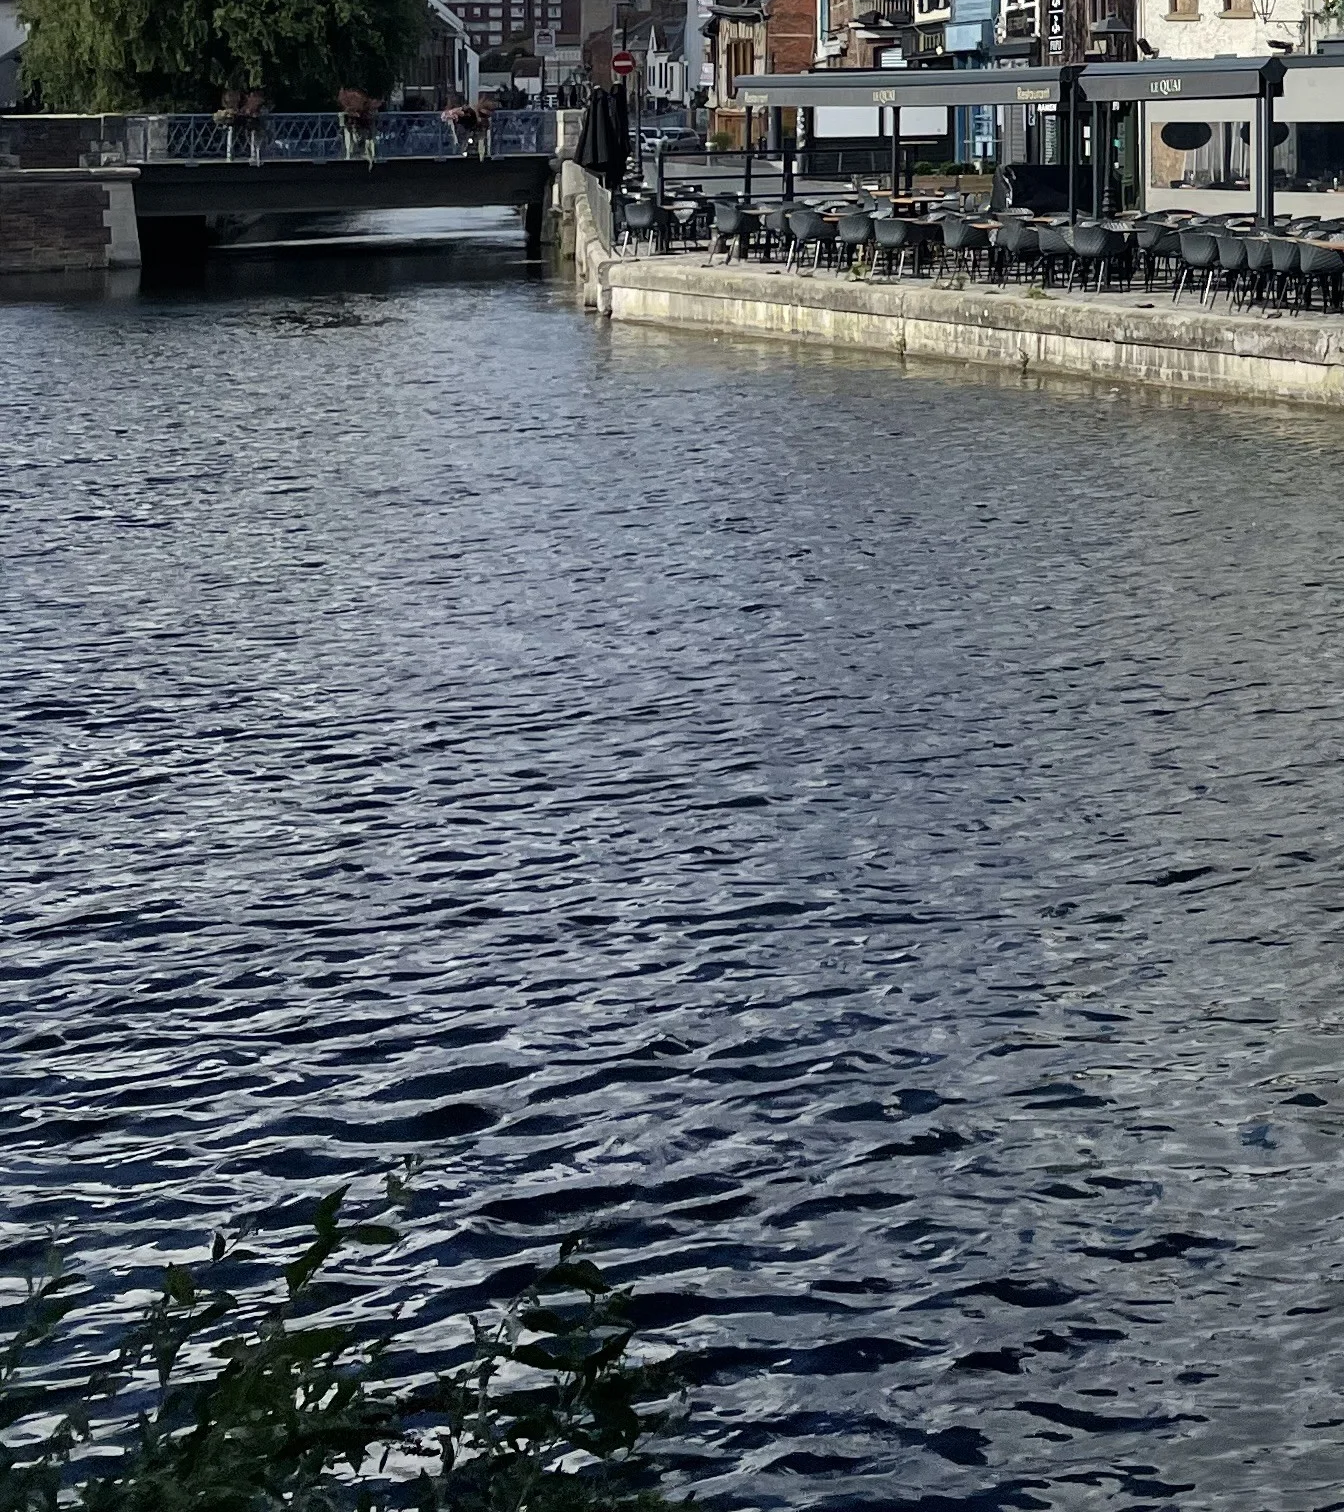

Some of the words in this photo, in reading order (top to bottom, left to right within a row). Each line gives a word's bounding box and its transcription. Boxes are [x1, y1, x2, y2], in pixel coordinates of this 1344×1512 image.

[1016, 87, 1050, 100] Restaurant
[1150, 83, 1158, 93] LE
[1159, 79, 1181, 95] QUAI
